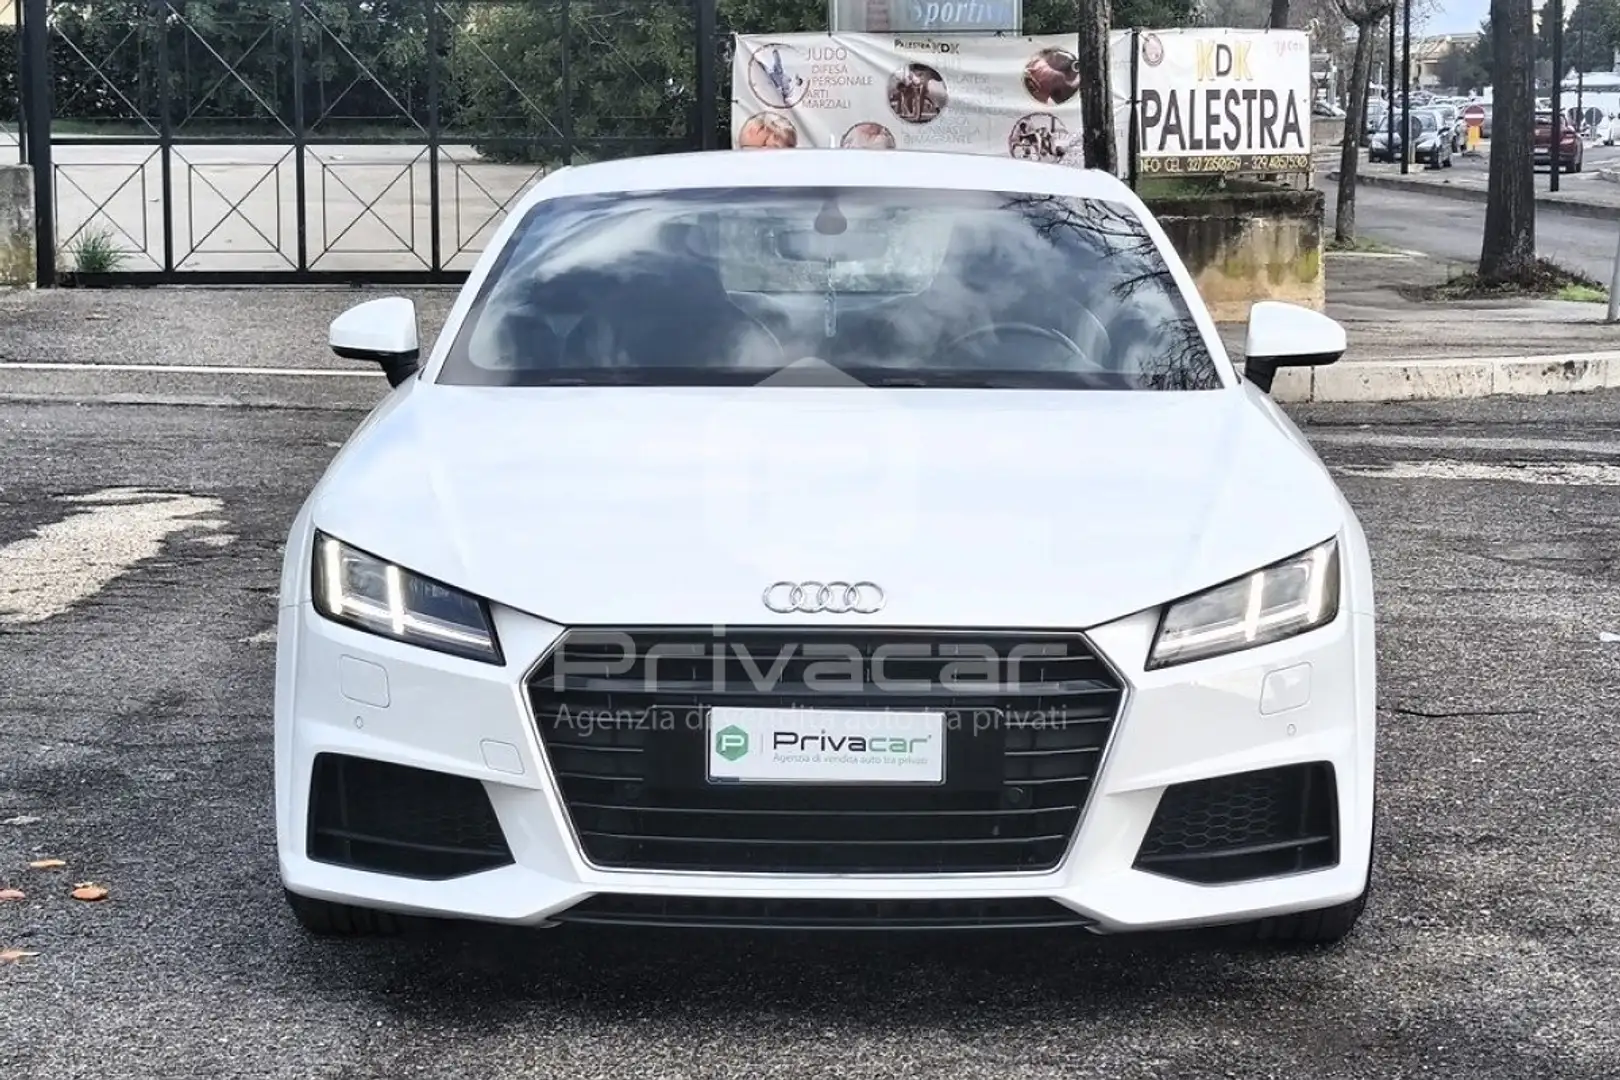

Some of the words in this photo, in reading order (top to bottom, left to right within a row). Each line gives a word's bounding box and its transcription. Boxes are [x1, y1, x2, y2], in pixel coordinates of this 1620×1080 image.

[806, 46, 848, 61] JUDO
[1196, 39, 1254, 82] KDK
[811, 64, 849, 75] DIFESA
[812, 75, 874, 86] PERSONALE
[806, 89, 829, 98] ARTI
[801, 99, 851, 109] MARZIALI
[1140, 88, 1304, 151] PALESTRA
[773, 729, 928, 753] Privacar
[772, 754, 810, 764] Agenzia
[812, 754, 822, 763] di
[823, 755, 858, 765] vendita
[859, 756, 881, 765] auto
[883, 757, 897, 765] tra
[898, 757, 928, 767] privati
